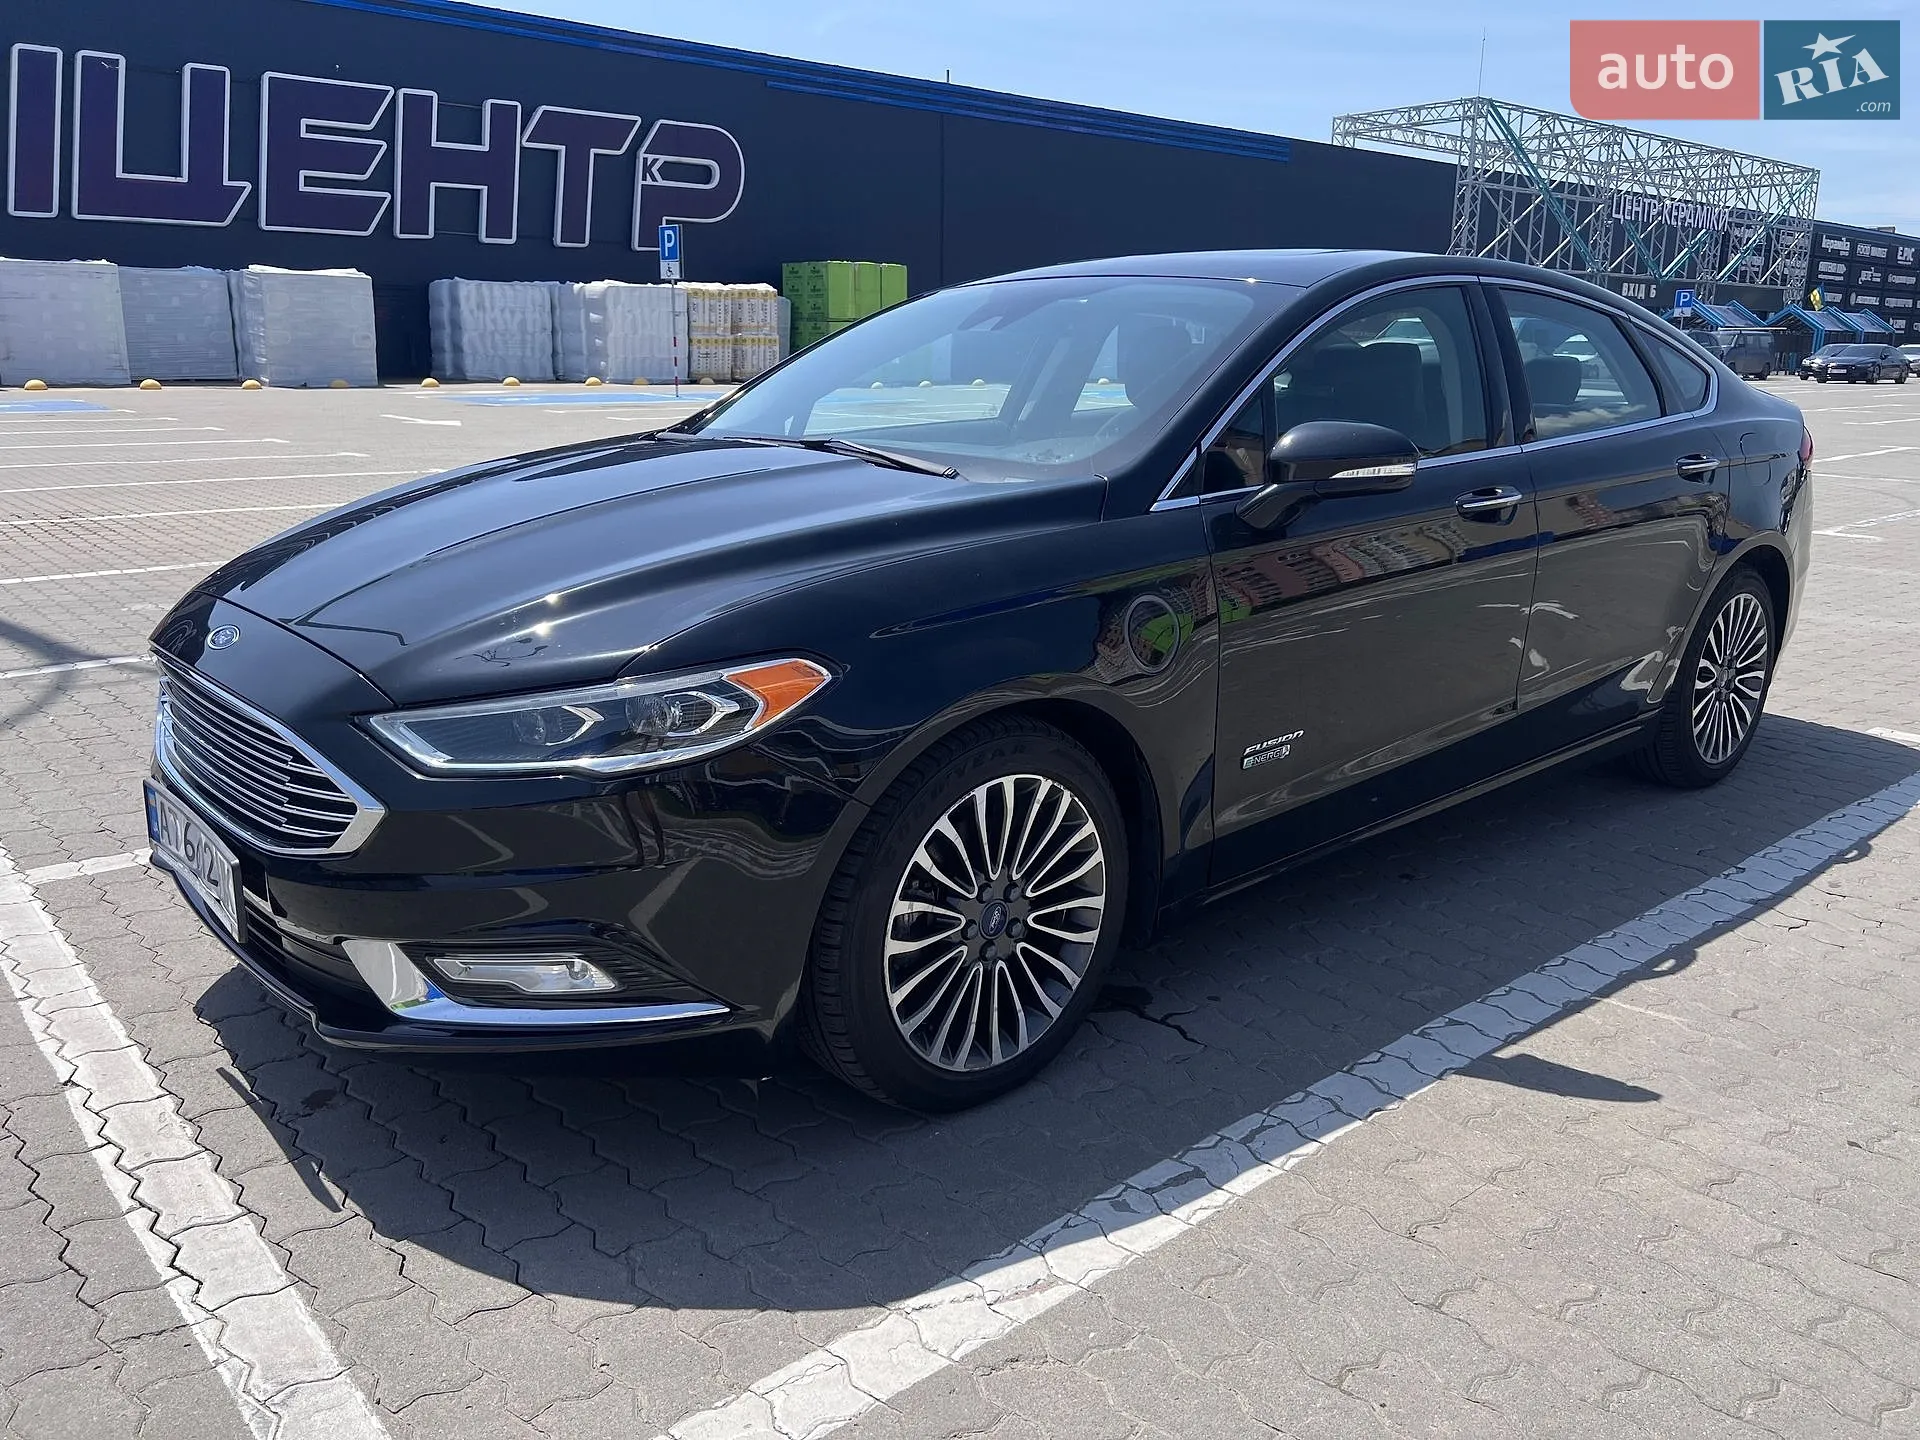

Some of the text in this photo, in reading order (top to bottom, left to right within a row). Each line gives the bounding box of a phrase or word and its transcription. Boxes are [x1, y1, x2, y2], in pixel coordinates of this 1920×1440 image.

[1612, 193, 1730, 232] ЦЕНТР КЕРАМІКИ
[664, 230, 675, 257] P
[1622, 282, 1646, 300] ВХІД
[1679, 292, 1690, 306] P
[1243, 729, 1305, 756] FUSION
